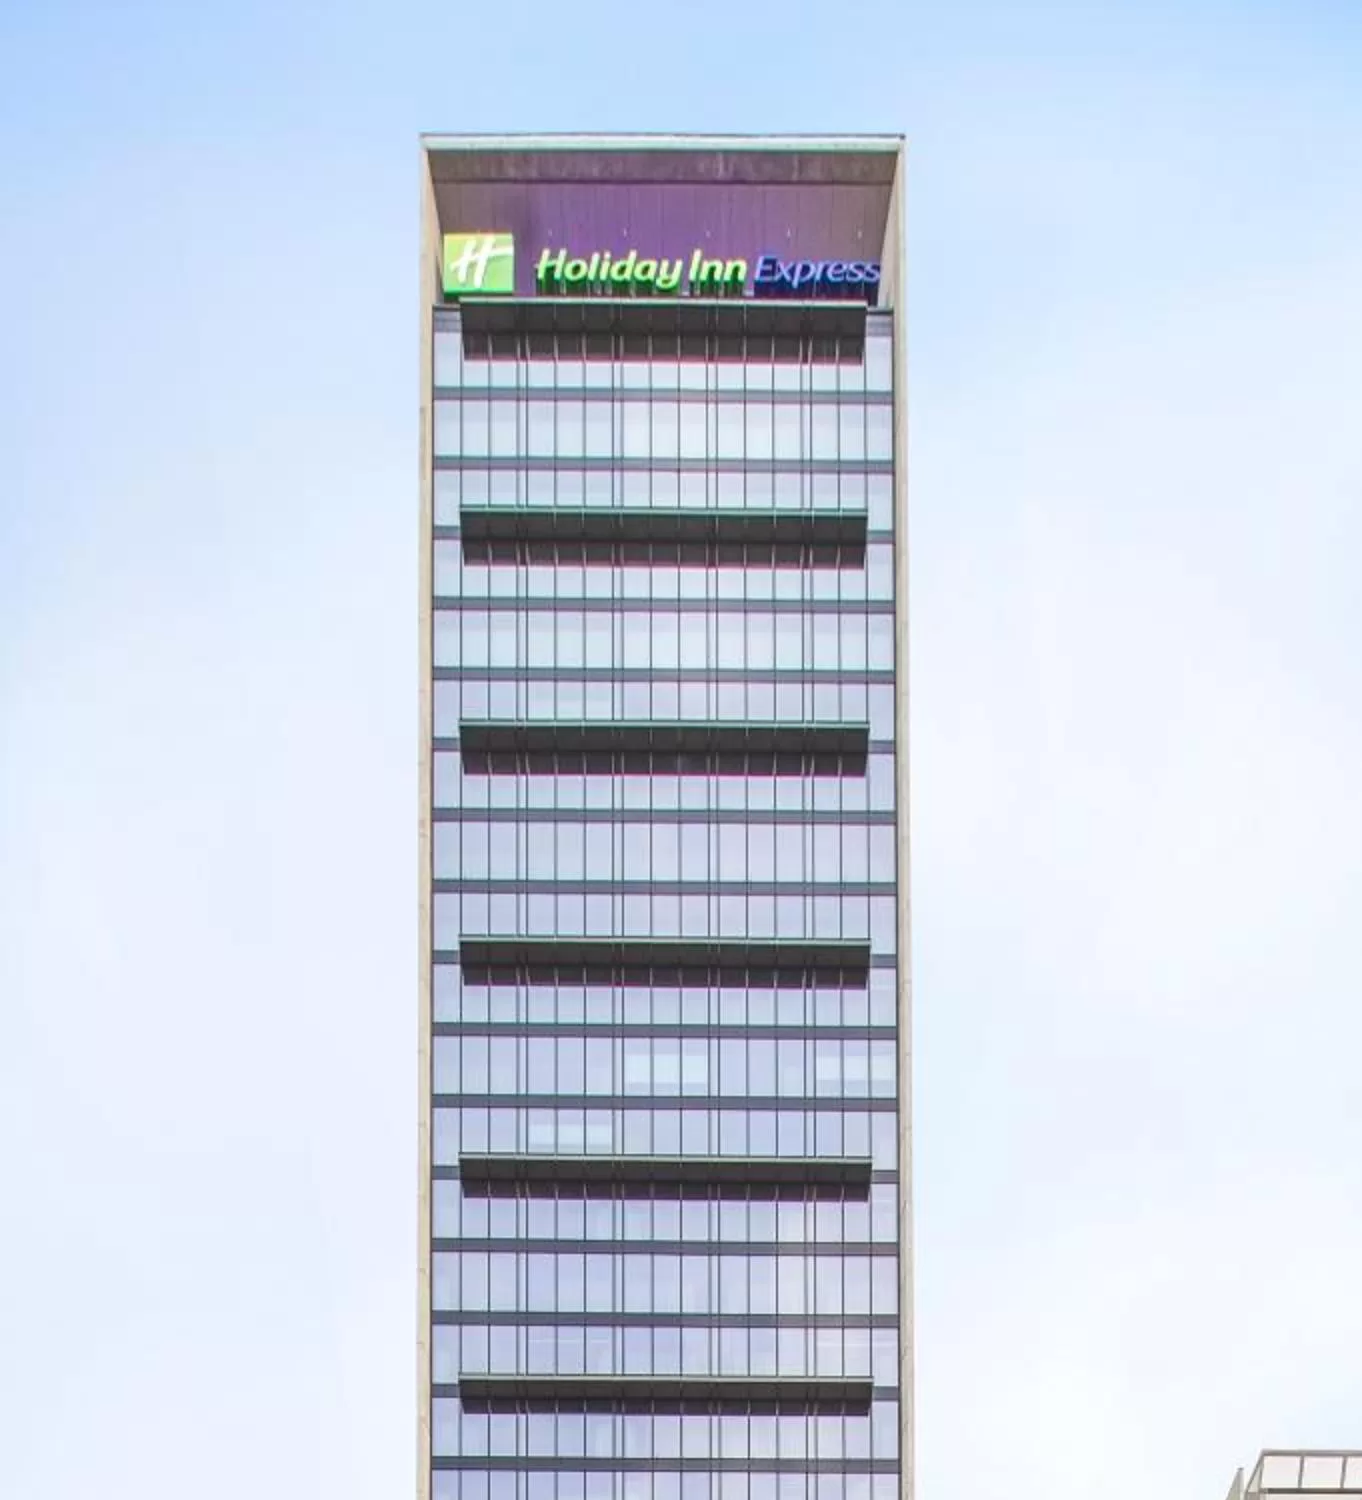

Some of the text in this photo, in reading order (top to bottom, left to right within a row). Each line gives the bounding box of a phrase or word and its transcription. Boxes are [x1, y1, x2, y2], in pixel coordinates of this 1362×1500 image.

[536, 248, 880, 290] Holiday Inn Express
